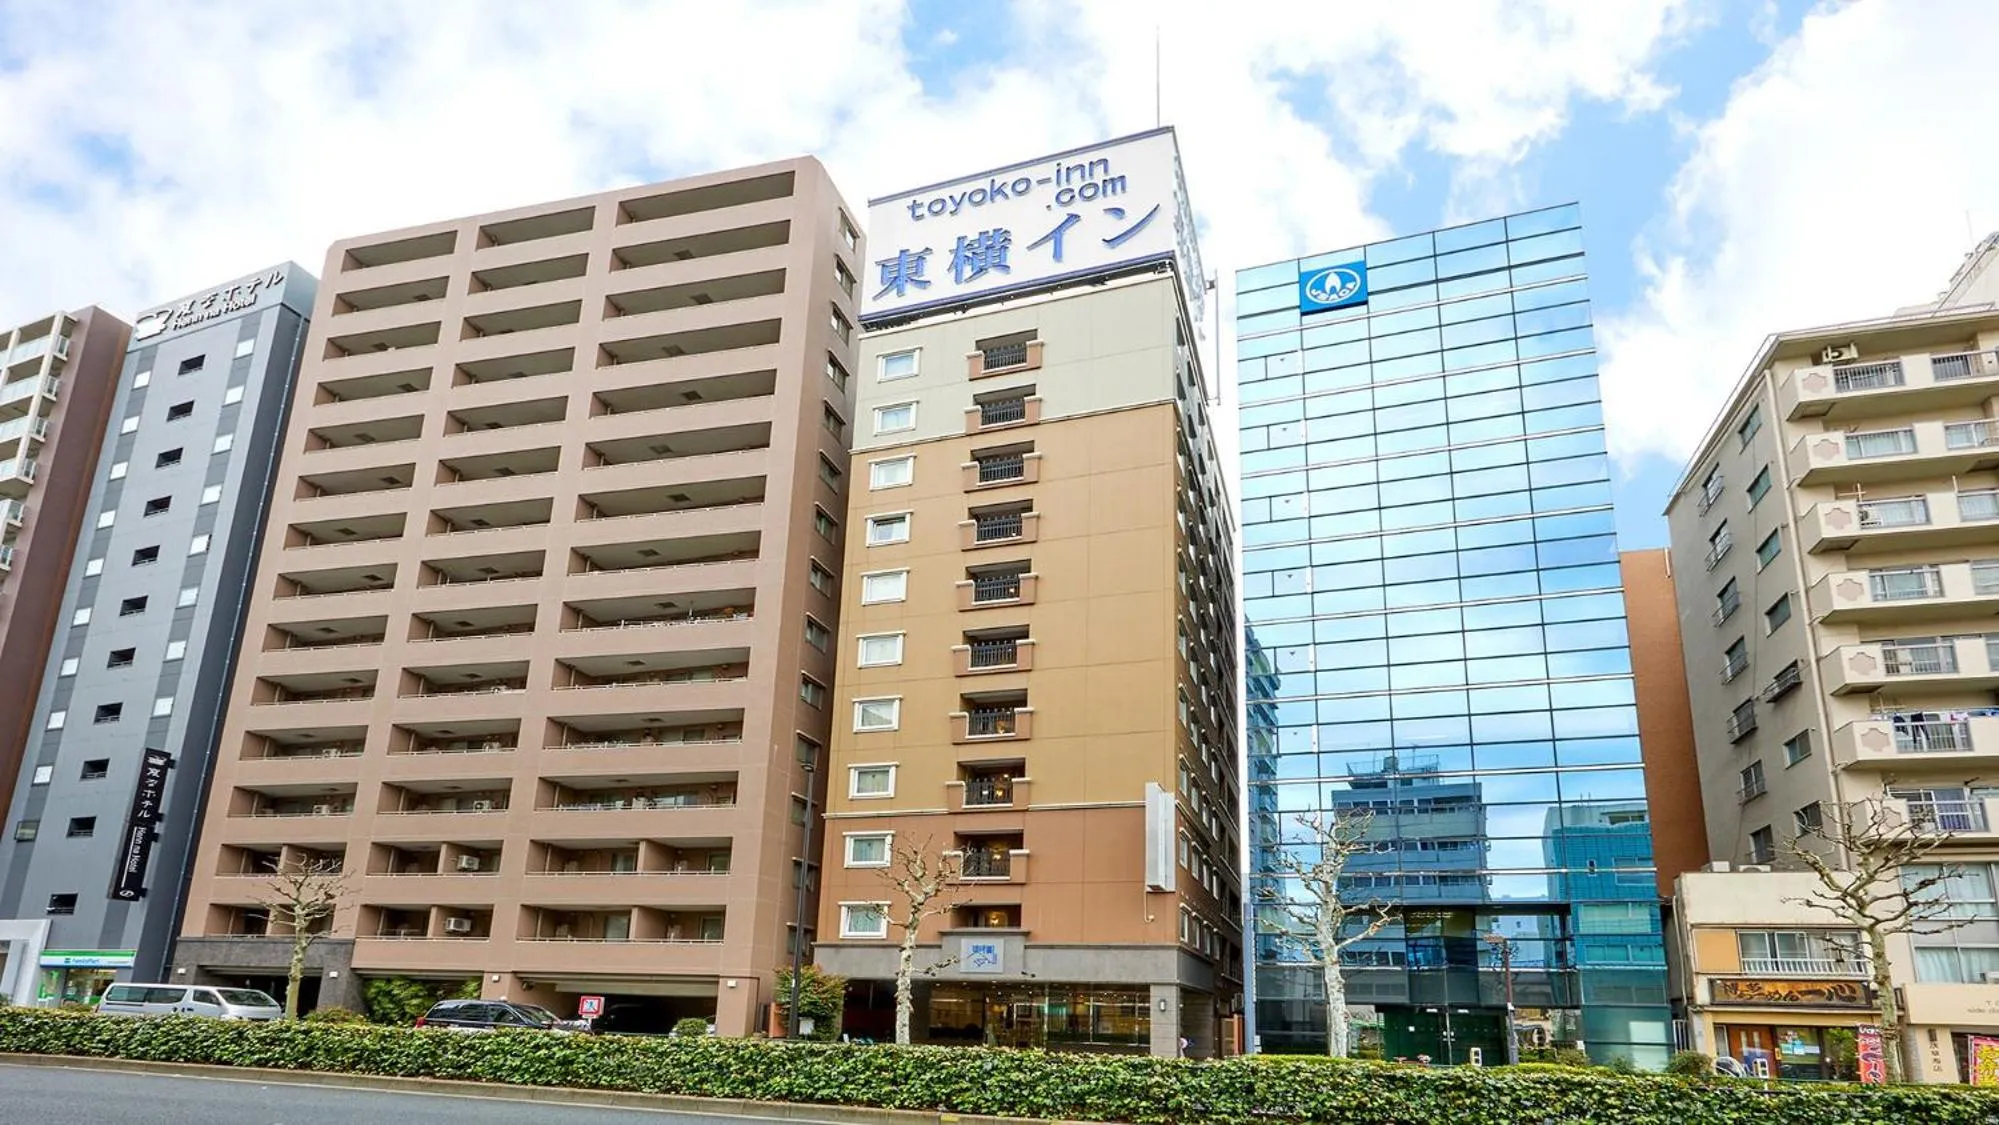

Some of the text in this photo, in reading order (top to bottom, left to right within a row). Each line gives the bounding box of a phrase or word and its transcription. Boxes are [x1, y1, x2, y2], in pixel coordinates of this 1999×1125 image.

[907, 156, 1109, 221] toyoko-inn
[1046, 174, 1127, 212] .com
[871, 203, 1161, 301] 東横イン
[223, 294, 258, 315] Hotel
